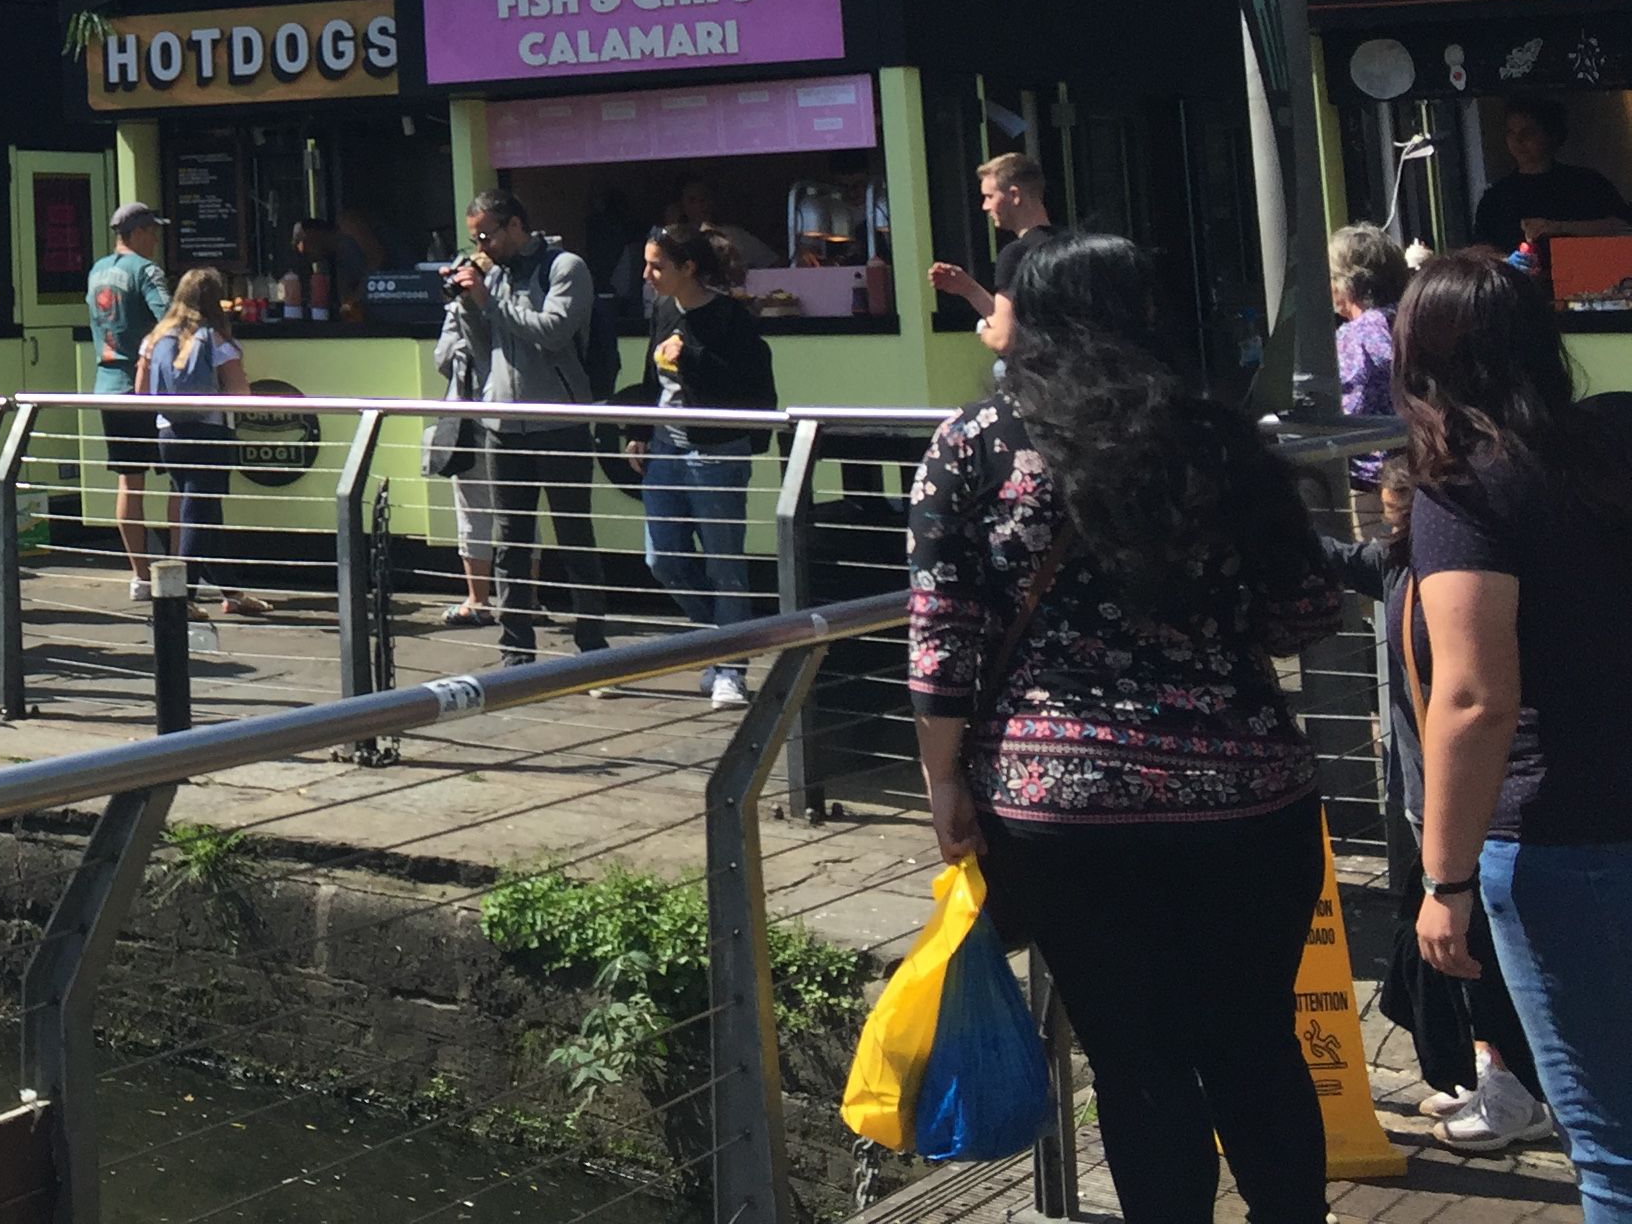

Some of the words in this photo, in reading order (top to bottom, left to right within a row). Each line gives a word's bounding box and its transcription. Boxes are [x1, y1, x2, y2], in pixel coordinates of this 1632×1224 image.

[104, 14, 398, 90] HOTDOGS
[517, 19, 739, 68] CALAMARI
[1307, 926, 1336, 945] DADO
